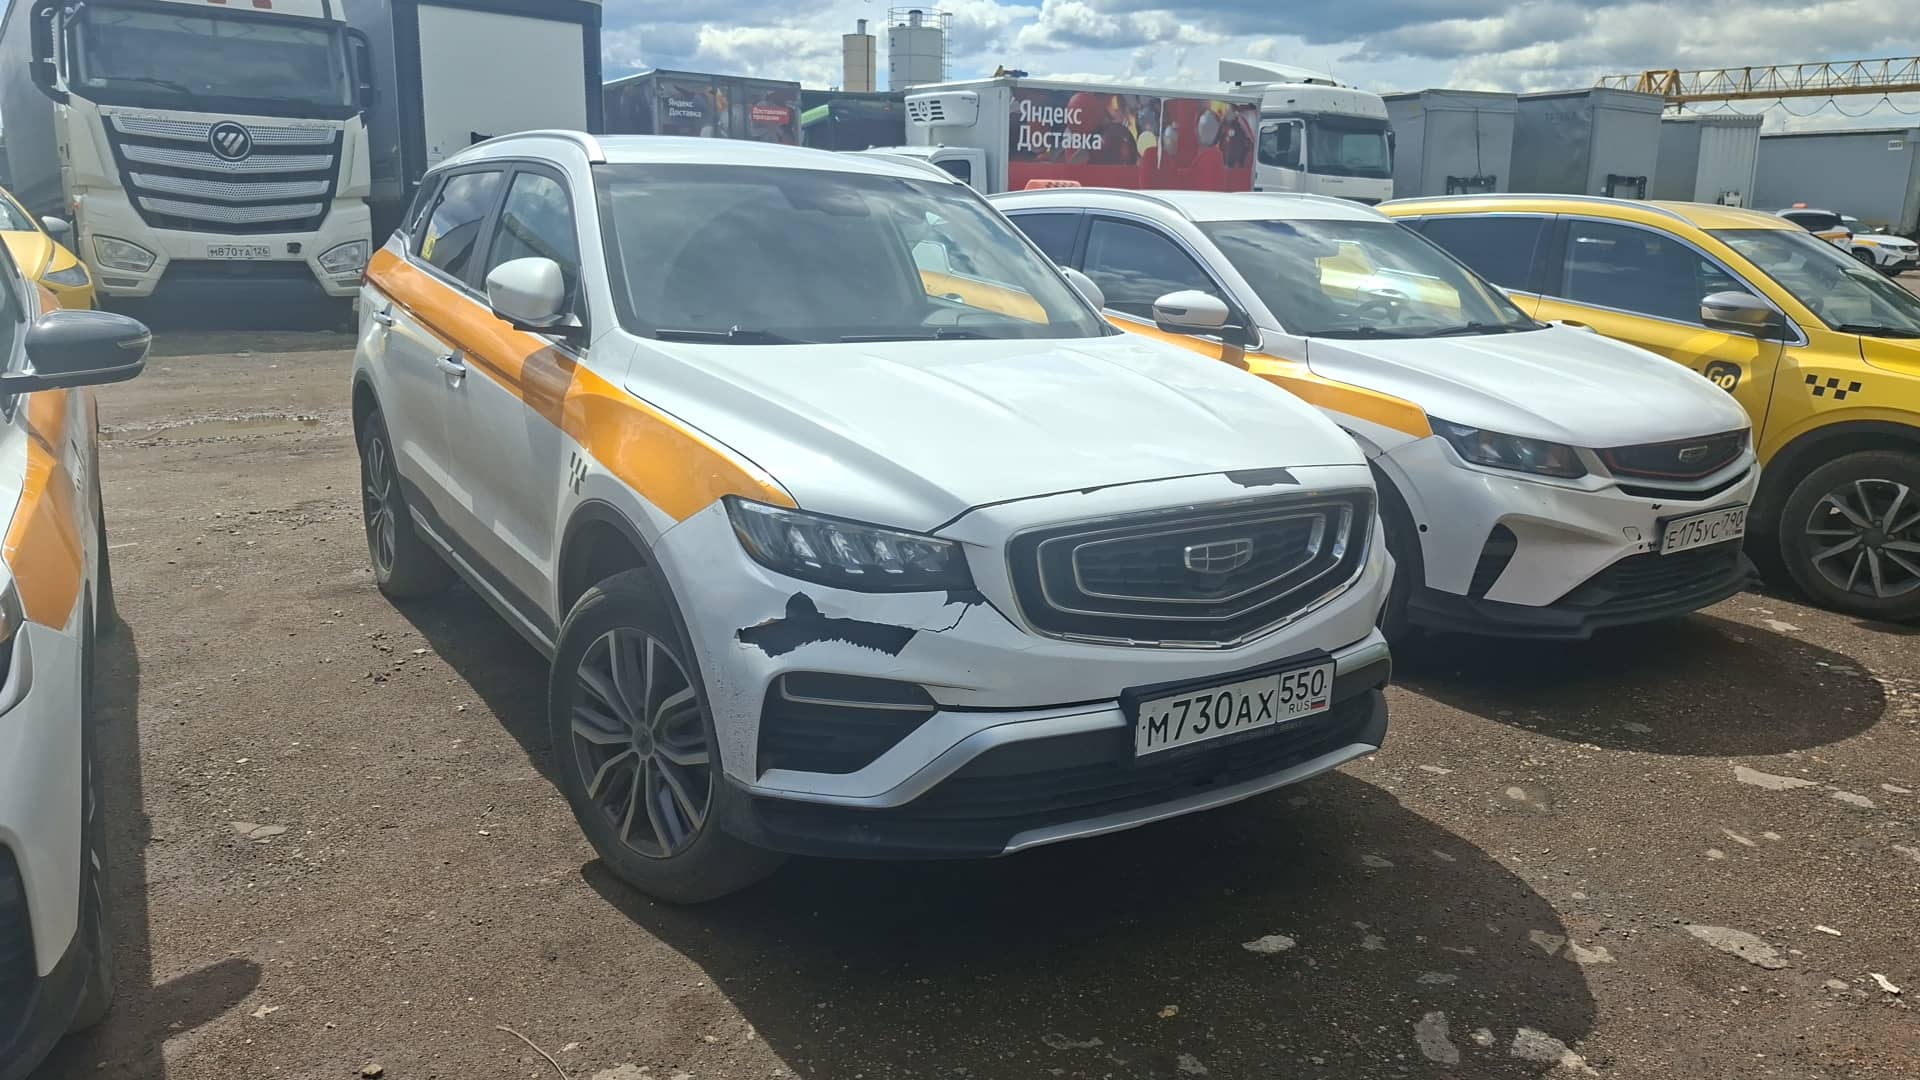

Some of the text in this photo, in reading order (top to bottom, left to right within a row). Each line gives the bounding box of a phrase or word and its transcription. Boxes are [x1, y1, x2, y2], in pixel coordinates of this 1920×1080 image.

[1019, 100, 1082, 126] Яндекс
[1017, 125, 1102, 151] Доставка
[1147, 669, 1325, 747] М730АХ 550
[1288, 702, 1310, 714] RUS
